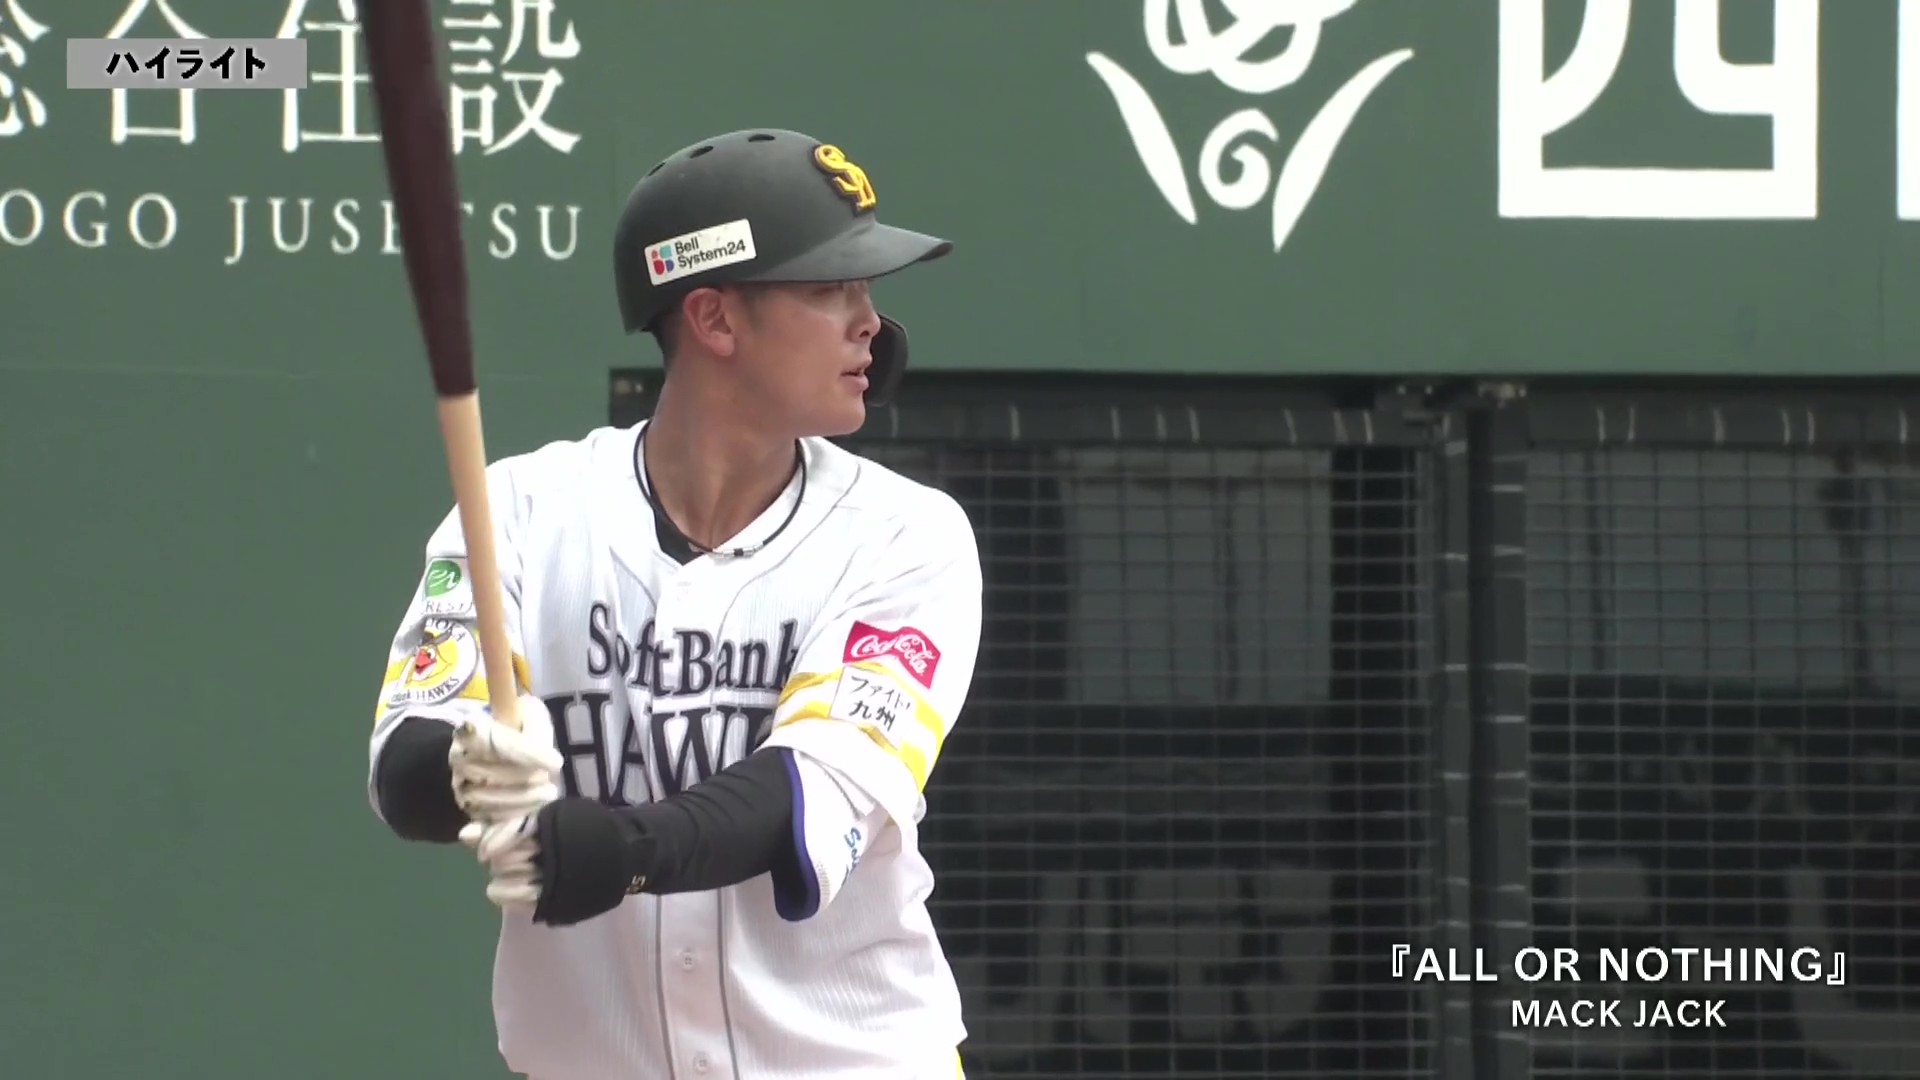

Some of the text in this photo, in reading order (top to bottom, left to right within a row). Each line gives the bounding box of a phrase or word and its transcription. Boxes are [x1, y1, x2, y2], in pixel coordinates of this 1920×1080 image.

[223, 195, 583, 265] JUSSU
[674, 236, 700, 255] Bell
[677, 239, 746, 269] System24
[847, 699, 896, 732] 九州
